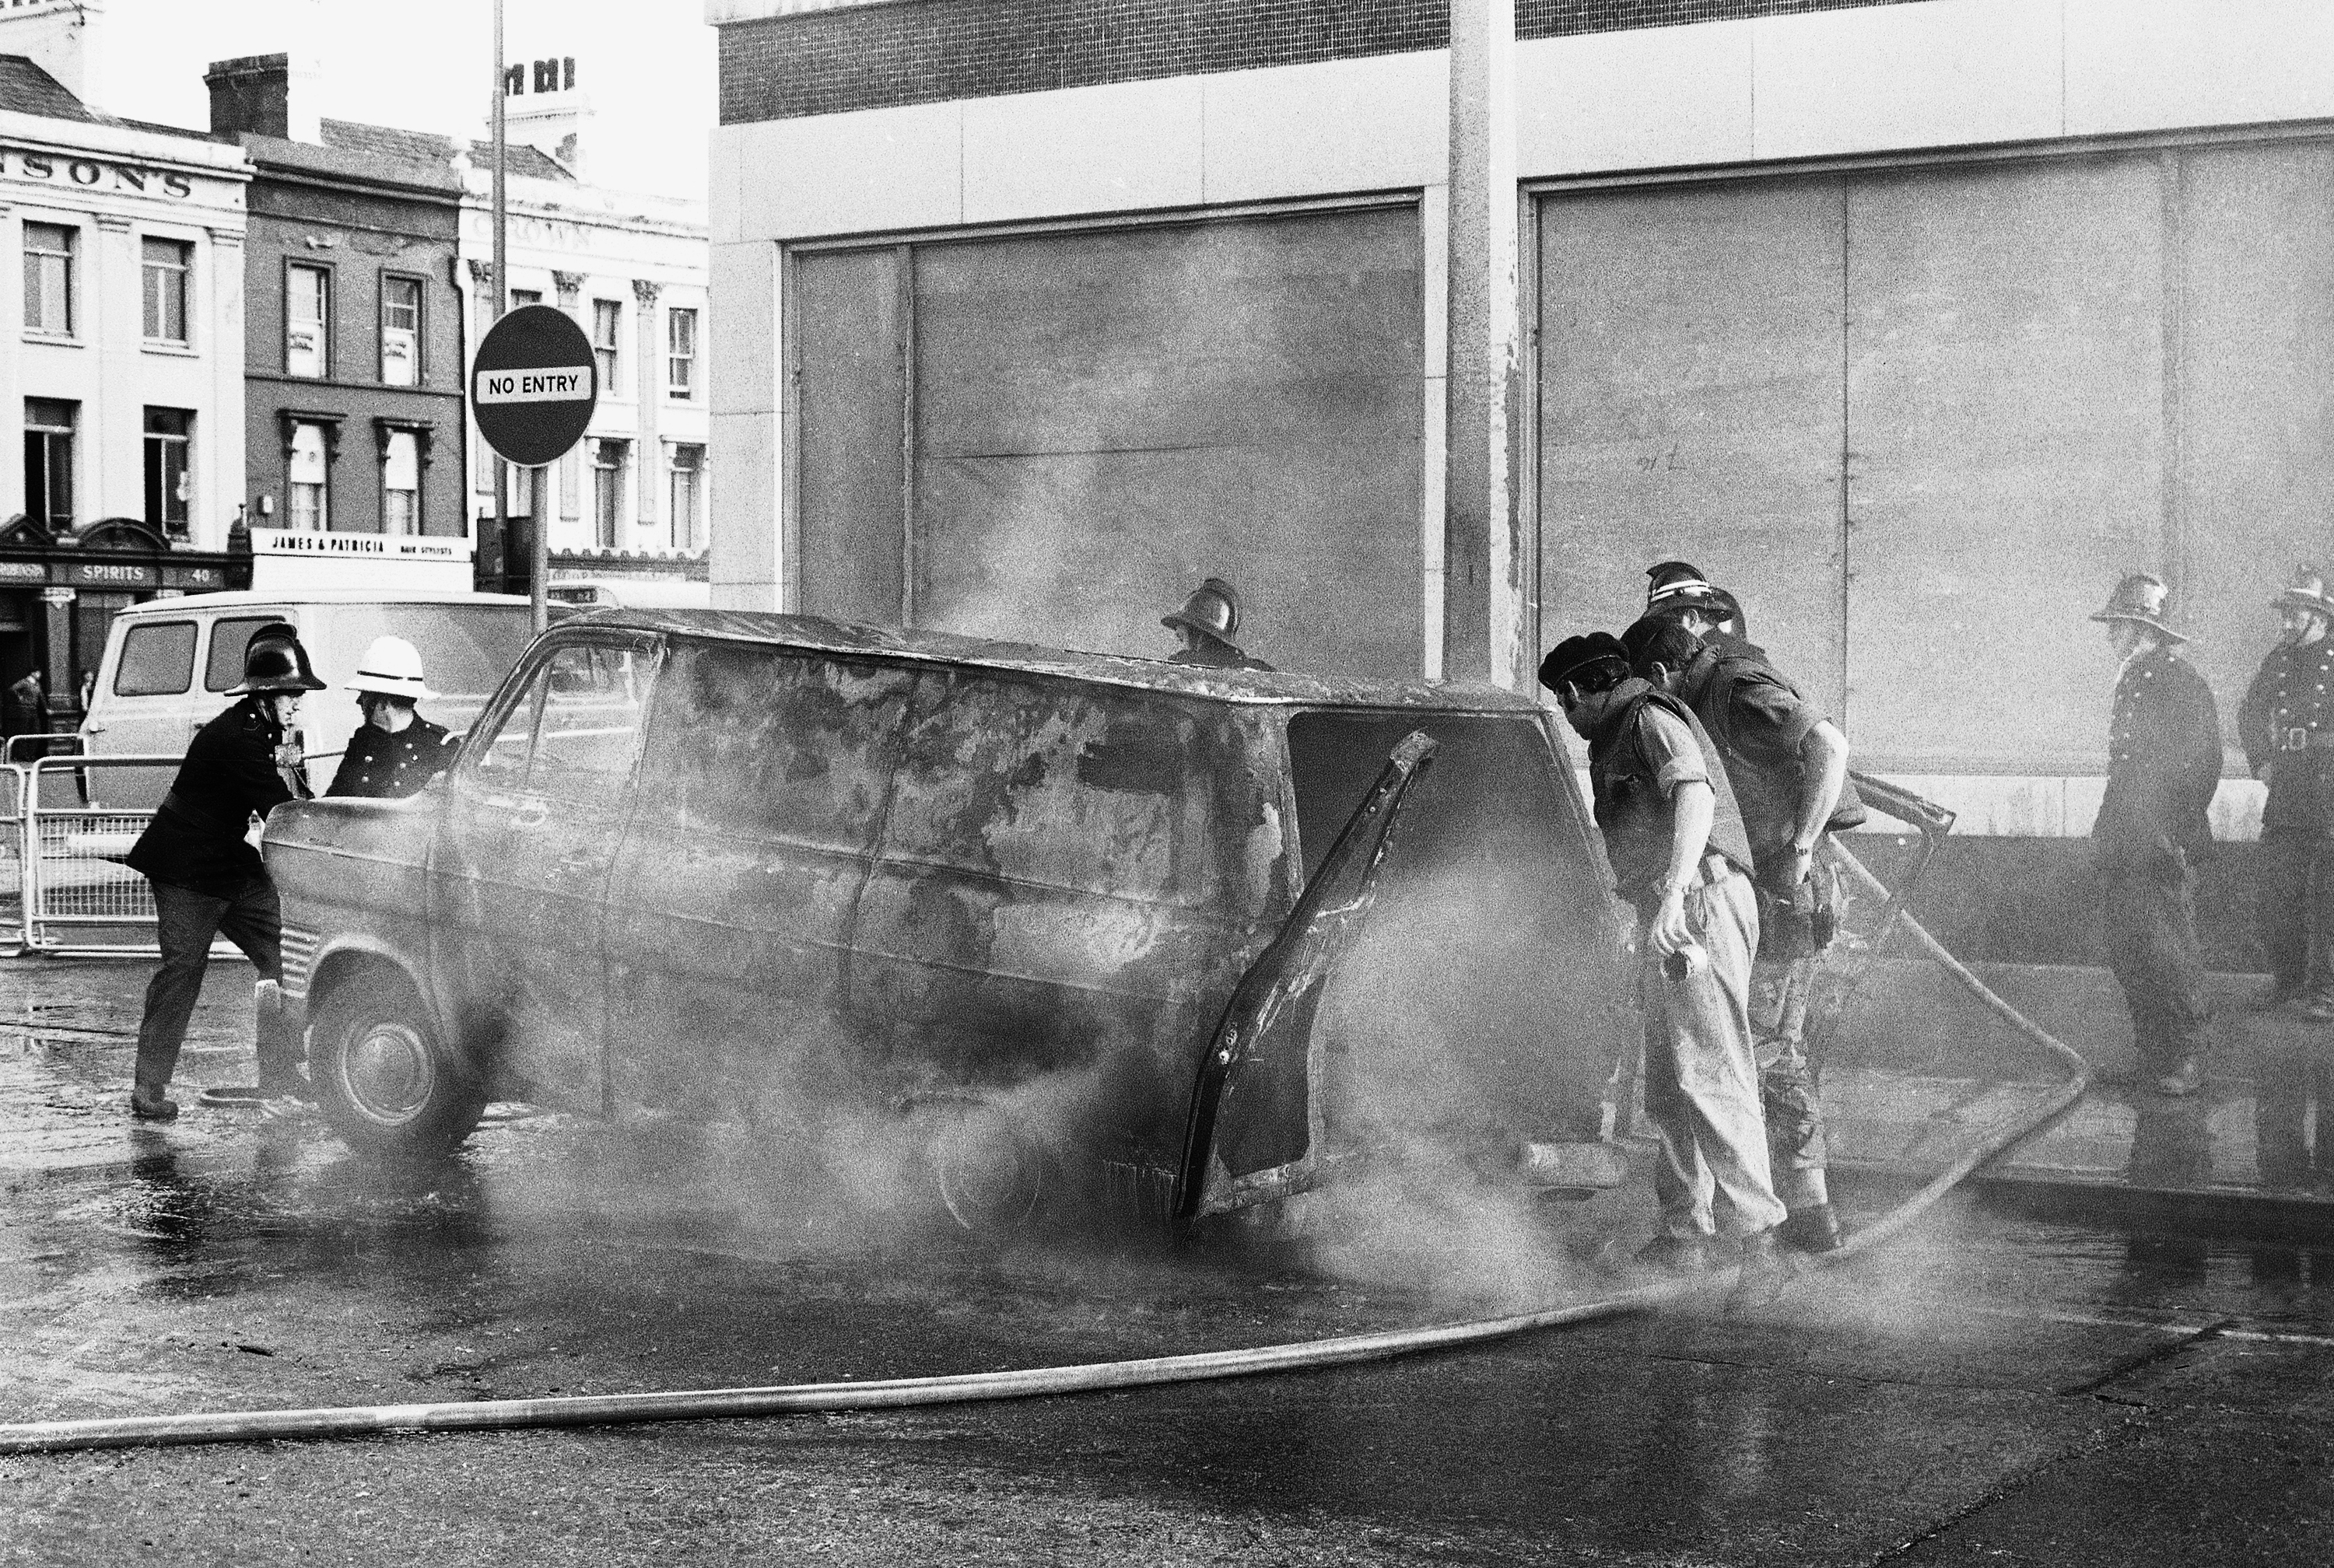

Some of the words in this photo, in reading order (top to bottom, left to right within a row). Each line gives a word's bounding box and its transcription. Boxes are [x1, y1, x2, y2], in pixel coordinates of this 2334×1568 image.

[0, 156, 191, 198] SON'S
[489, 378, 514, 394] NO
[523, 375, 578, 393] ENTRY
[272, 537, 312, 549] JAMES
[318, 538, 325, 550] &
[331, 539, 384, 551] PATRICIA
[82, 565, 144, 580] SPIRITS
